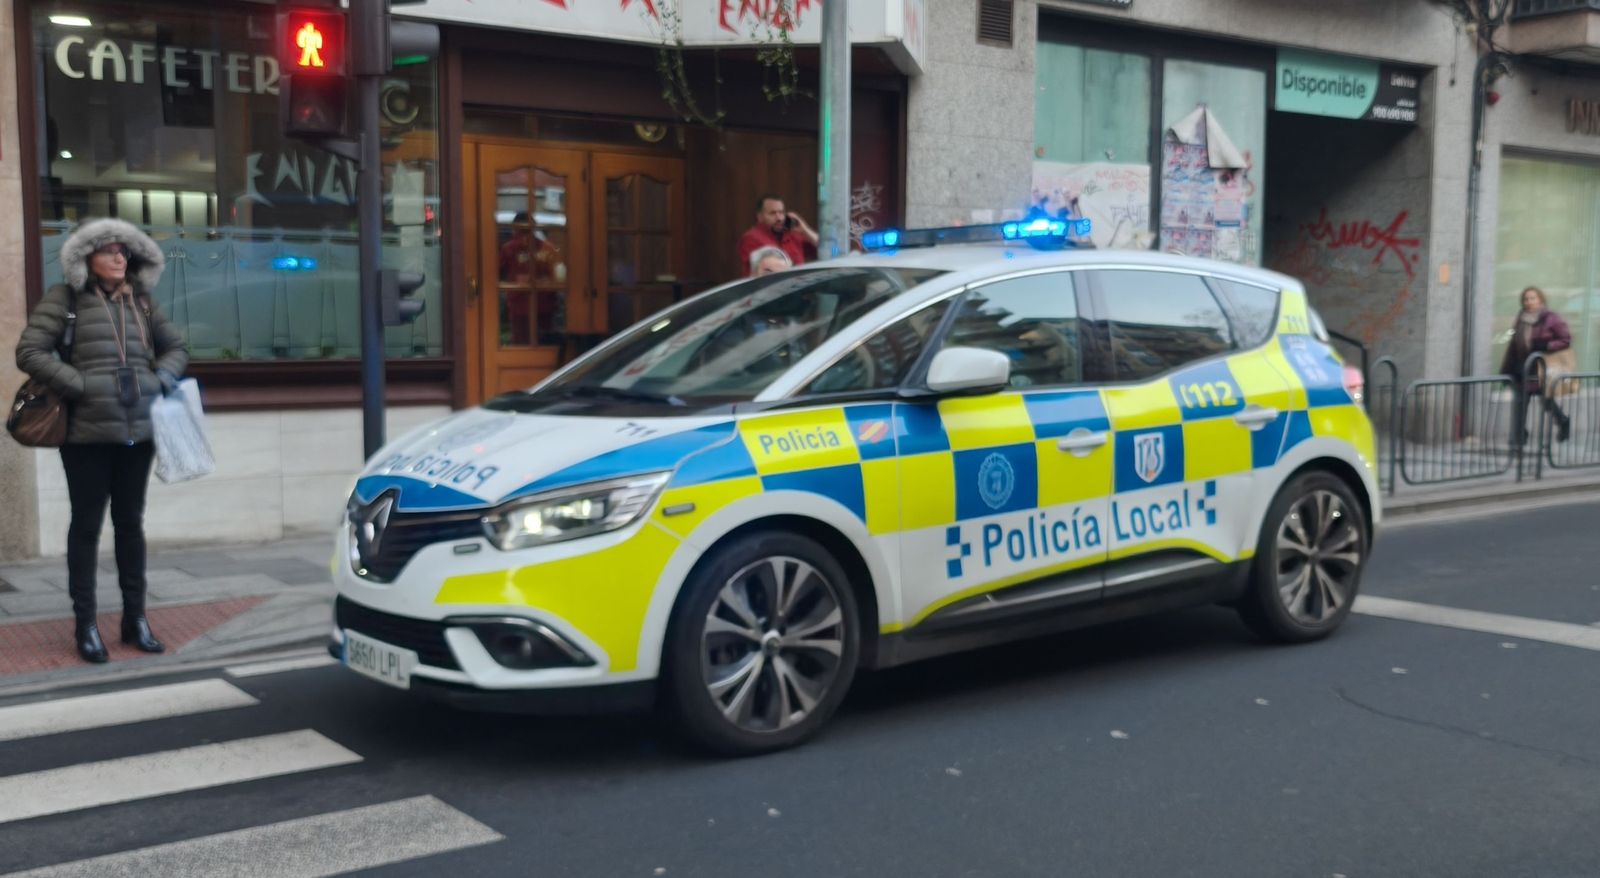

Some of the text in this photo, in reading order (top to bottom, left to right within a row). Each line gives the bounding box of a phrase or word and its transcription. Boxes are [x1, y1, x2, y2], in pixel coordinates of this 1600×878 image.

[1281, 68, 1366, 99] Disponible
[1188, 380, 1237, 408] 112
[759, 426, 840, 455] Policía
[983, 488, 1192, 567] Policía Local
[380, 649, 406, 681] LPL
